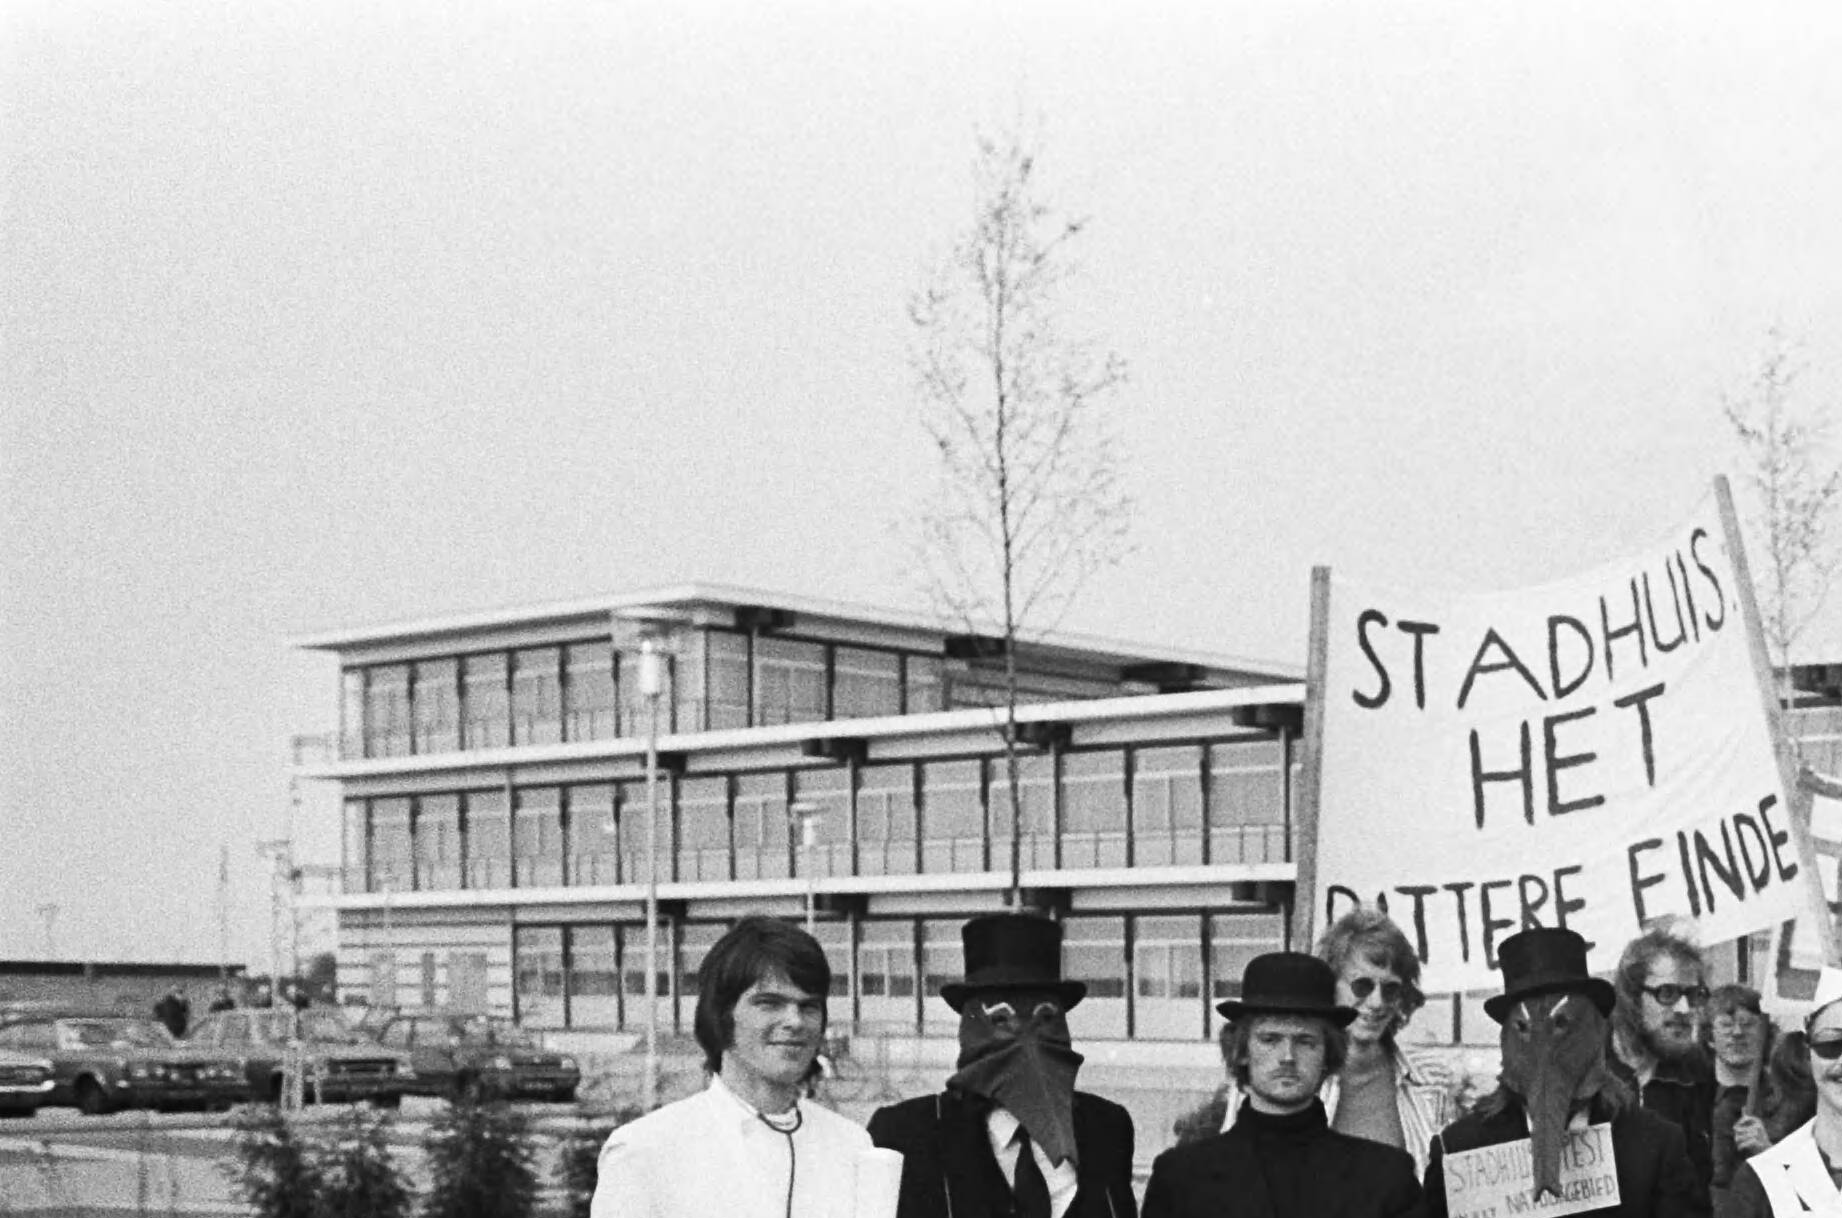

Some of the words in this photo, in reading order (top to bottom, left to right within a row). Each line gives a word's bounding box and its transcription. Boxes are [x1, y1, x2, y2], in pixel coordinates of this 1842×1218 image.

[1353, 527, 1725, 710] STADHUIS
[1468, 682, 1666, 829] HET
[1628, 794, 1798, 930] EINDE
